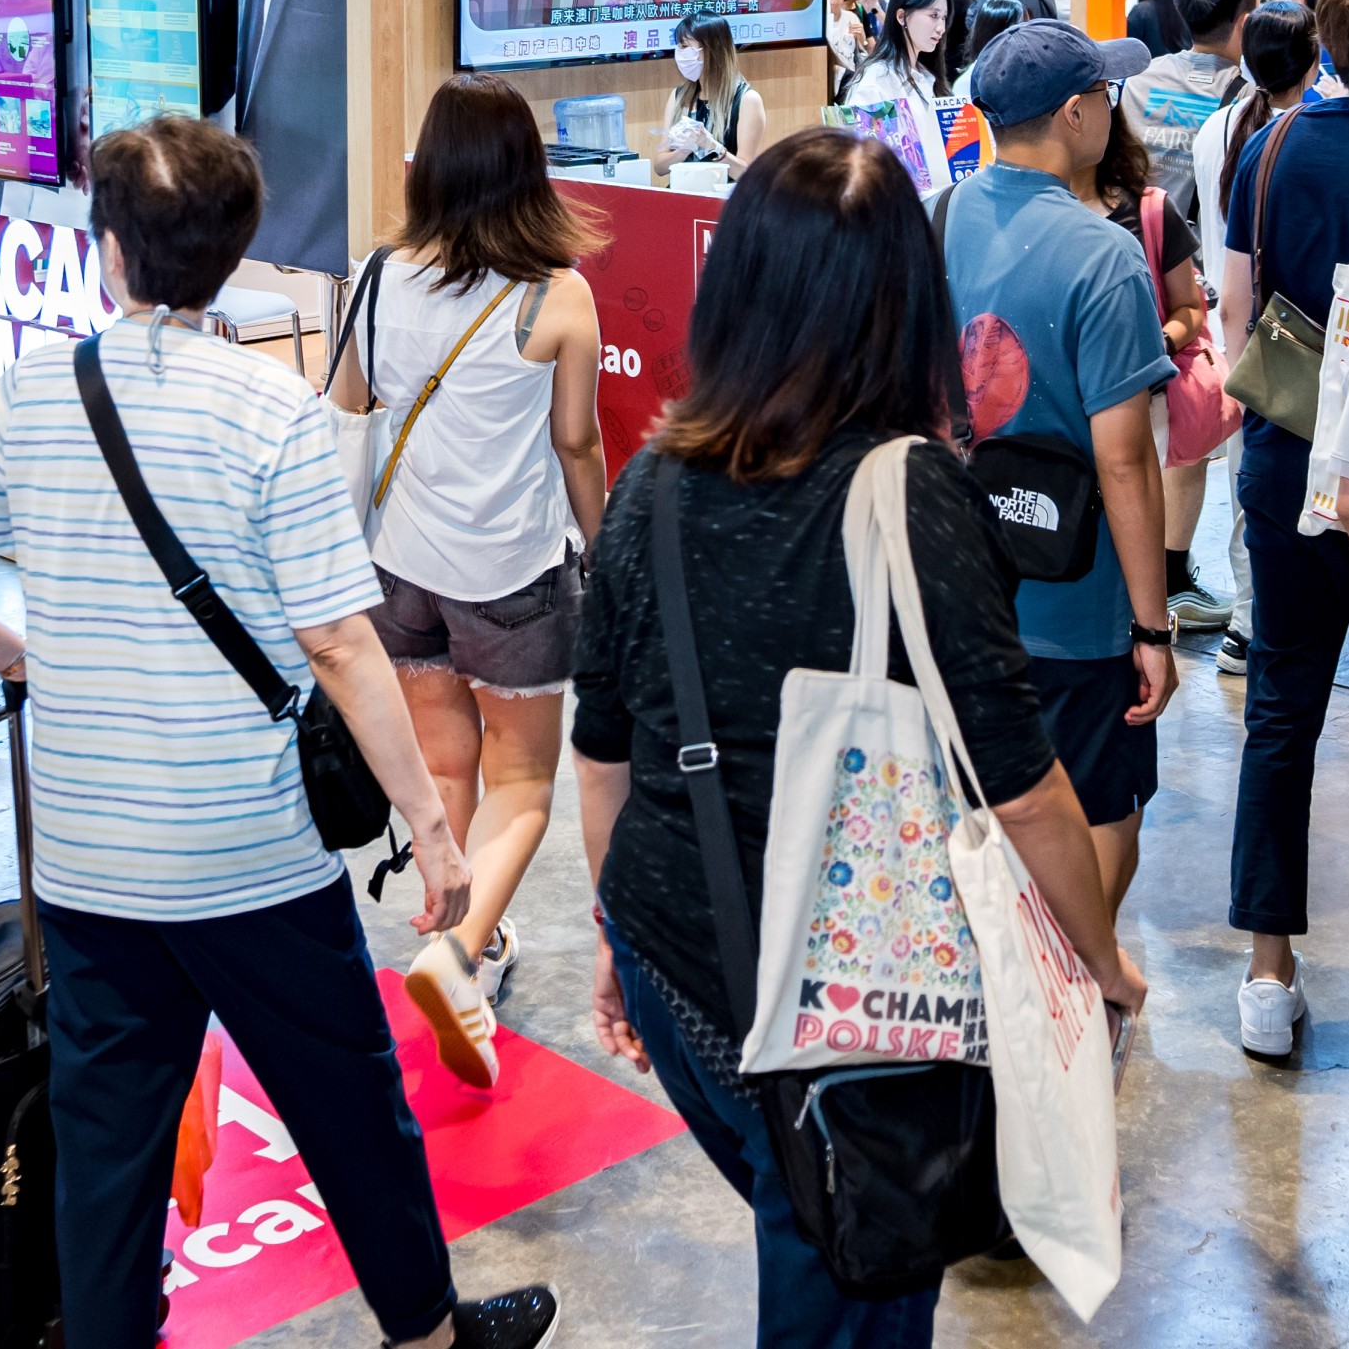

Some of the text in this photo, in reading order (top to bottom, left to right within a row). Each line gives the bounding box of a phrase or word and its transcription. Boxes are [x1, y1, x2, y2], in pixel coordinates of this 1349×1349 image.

[934, 97, 968, 108] MACAO
[1143, 126, 1196, 153] FAIR
[988, 493, 1036, 514] NORTH
[1011, 487, 1038, 503] THE
[998, 508, 1034, 526] FACE
